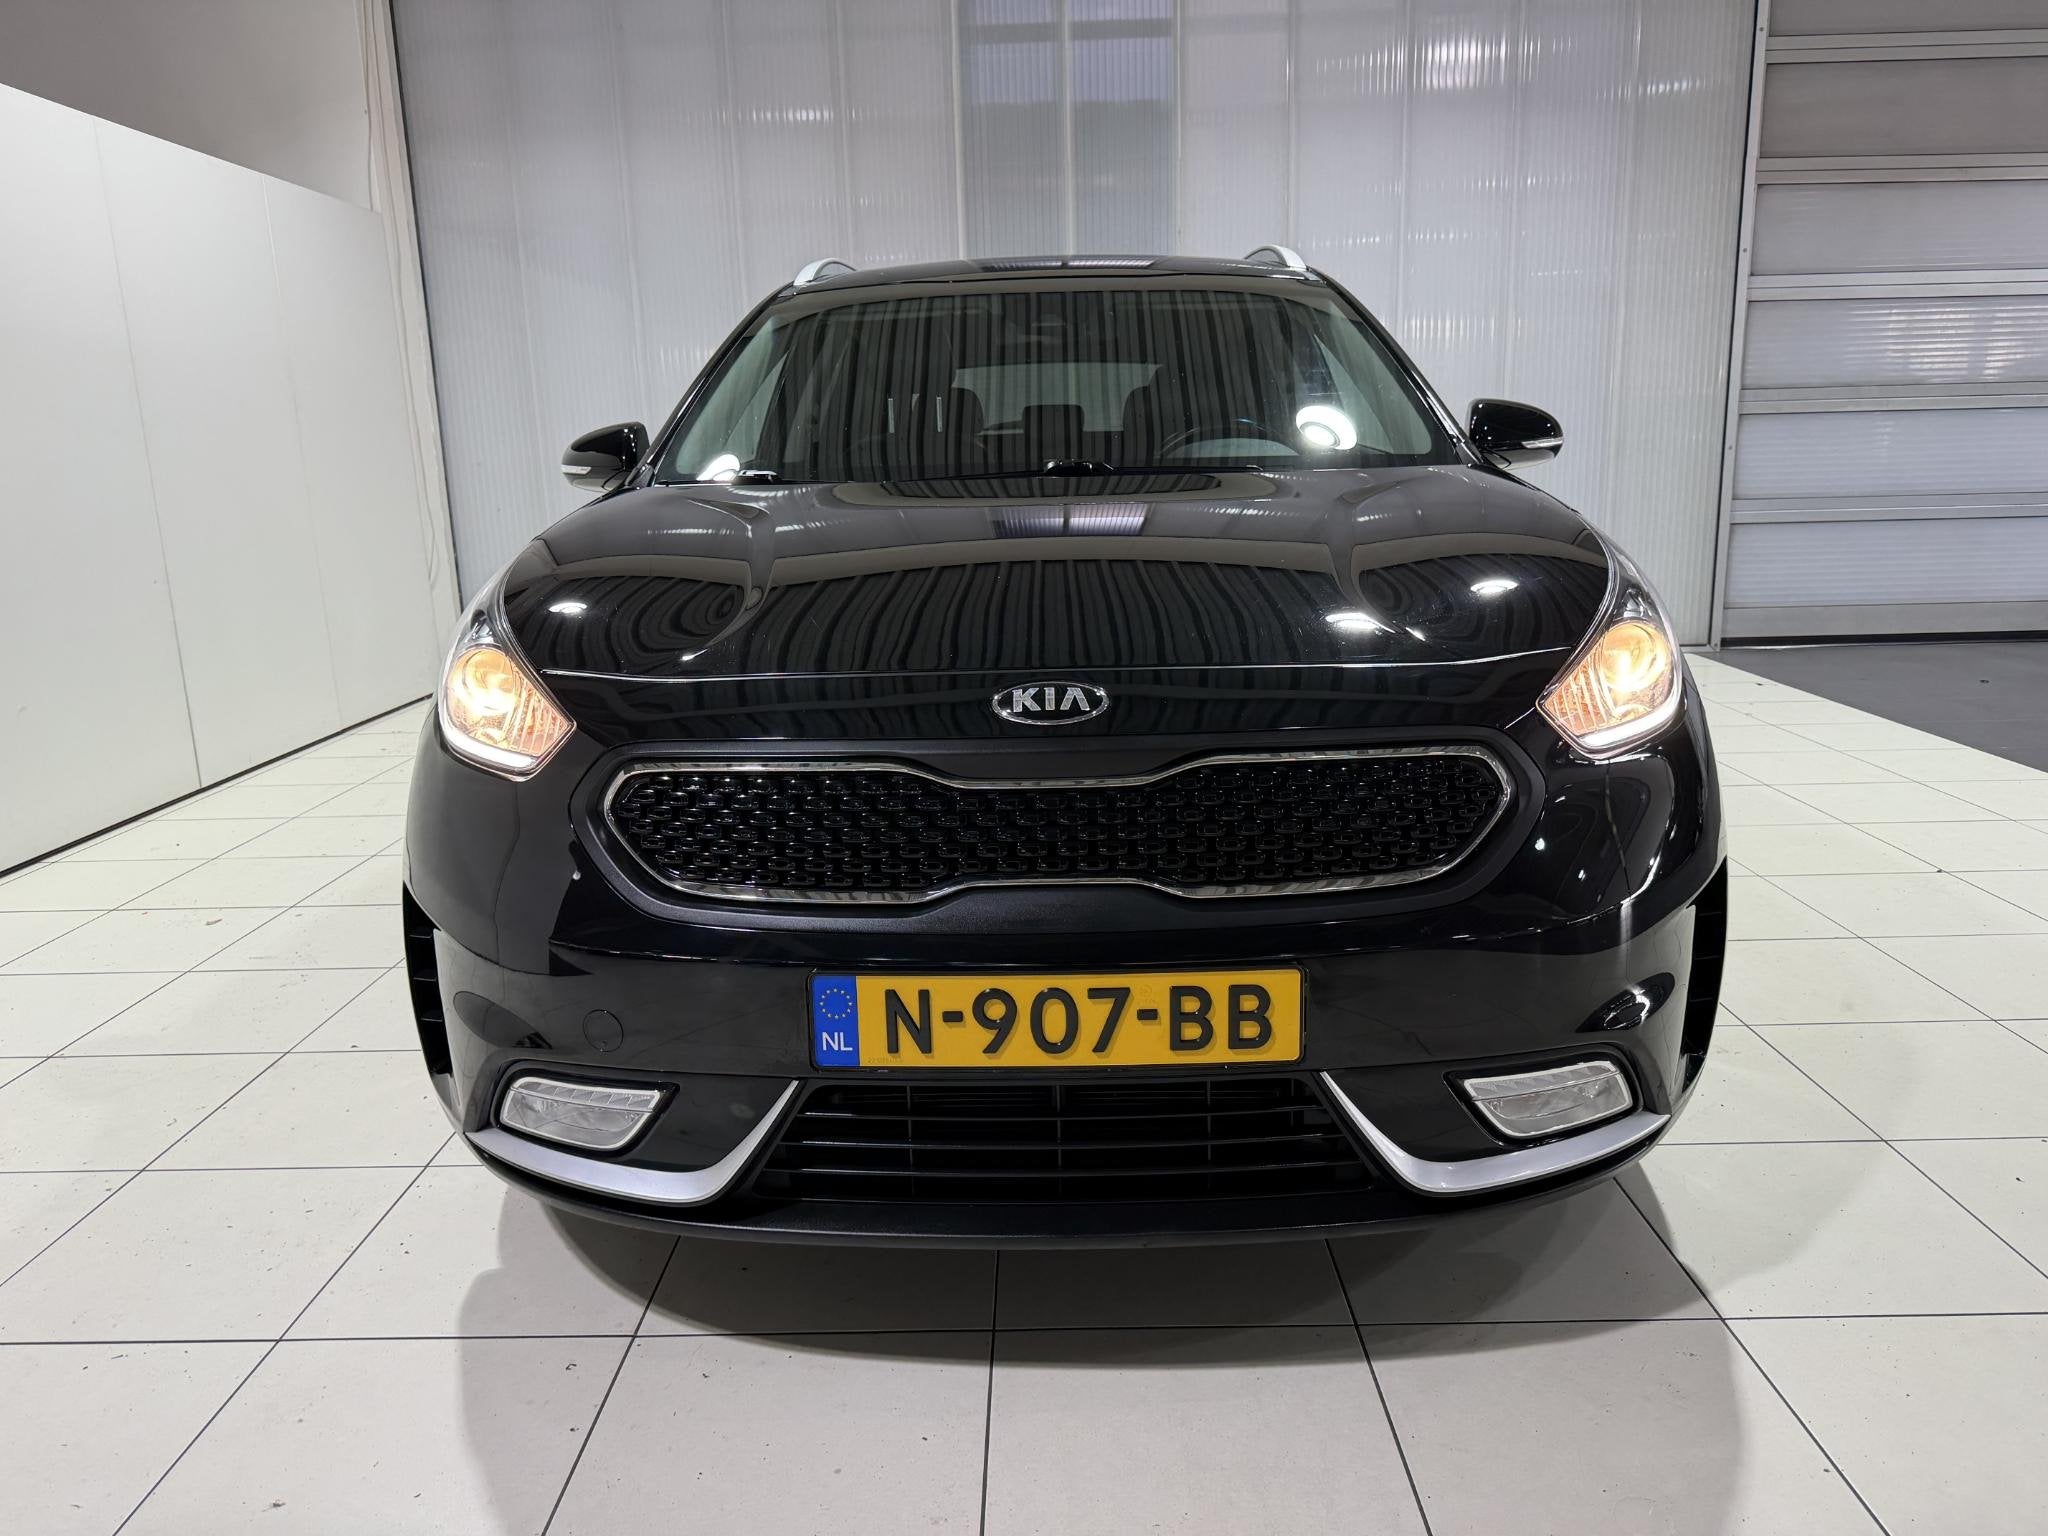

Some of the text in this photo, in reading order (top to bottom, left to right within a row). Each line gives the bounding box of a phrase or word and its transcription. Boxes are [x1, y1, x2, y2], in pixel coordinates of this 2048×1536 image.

[1011, 687, 1091, 713] KIA
[884, 985, 1273, 1054] N-907-BB
[821, 1031, 853, 1051] NL
